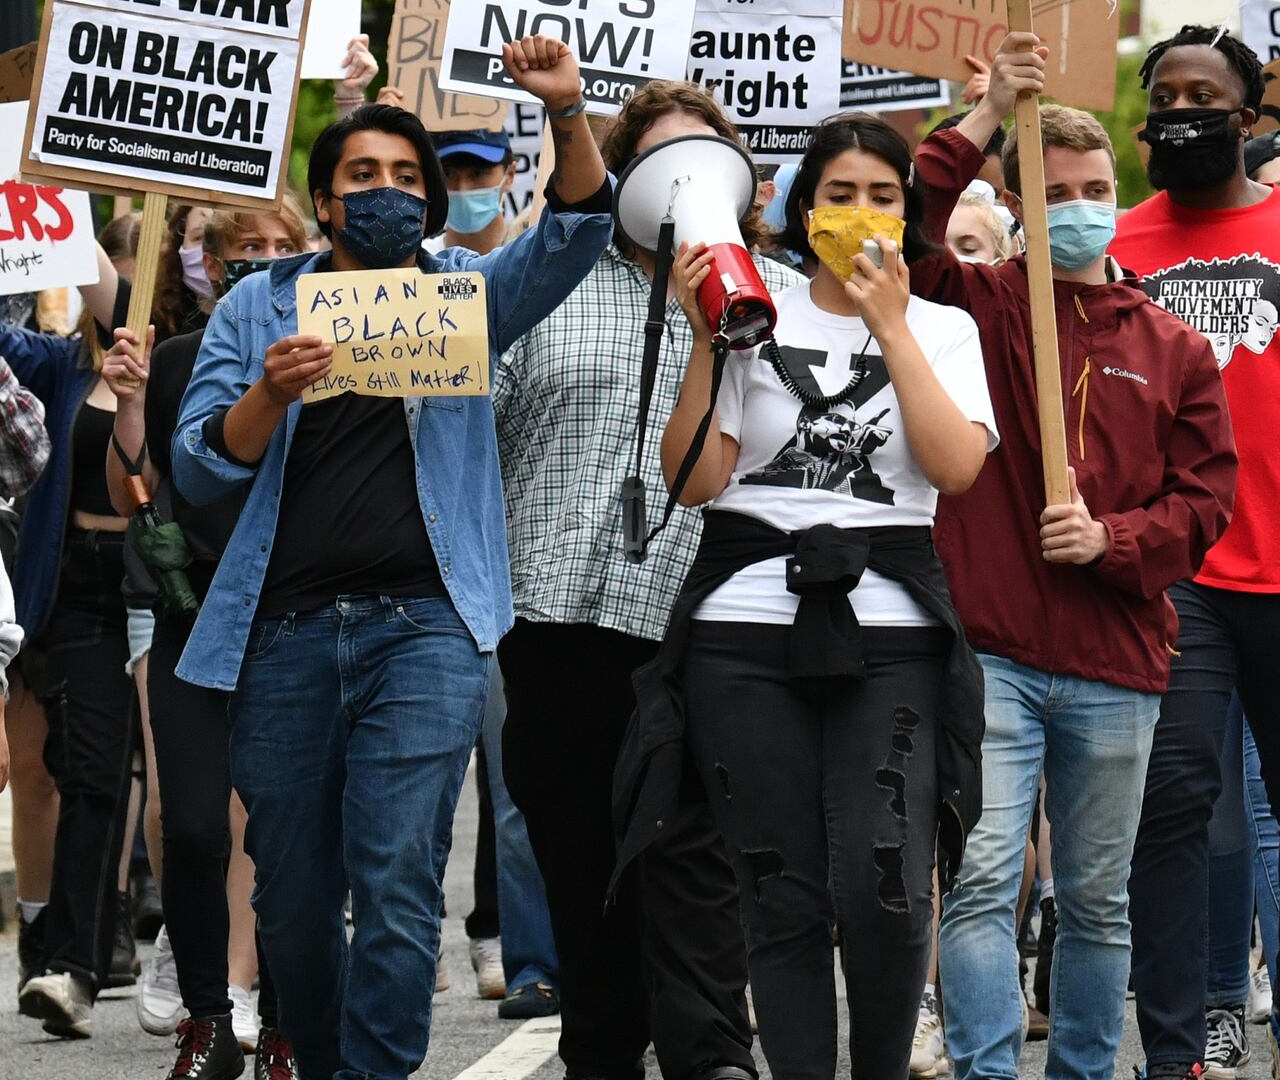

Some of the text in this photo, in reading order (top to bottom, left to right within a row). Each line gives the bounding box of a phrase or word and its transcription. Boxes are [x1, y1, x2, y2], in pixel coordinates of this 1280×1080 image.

[480, 4, 654, 72] NOW!
[68, 21, 127, 70] ON
[133, 30, 278, 94] BLACK
[58, 72, 268, 144] AMERICA!
[48, 129, 265, 177] Party for Socialism and Liberation
[442, 286, 474, 294] LIVES
[443, 277, 473, 286] BLACK
[1161, 280, 1264, 297] COMMUNITY
[310, 279, 418, 314] ASIAN
[443, 293, 475, 301] MATTER
[1164, 298, 1258, 315] MOVEMENT
[332, 307, 458, 346] BLACK
[352, 335, 447, 364] BROWN
[312, 372, 358, 393] Lives
[1112, 367, 1149, 386] Columbia
